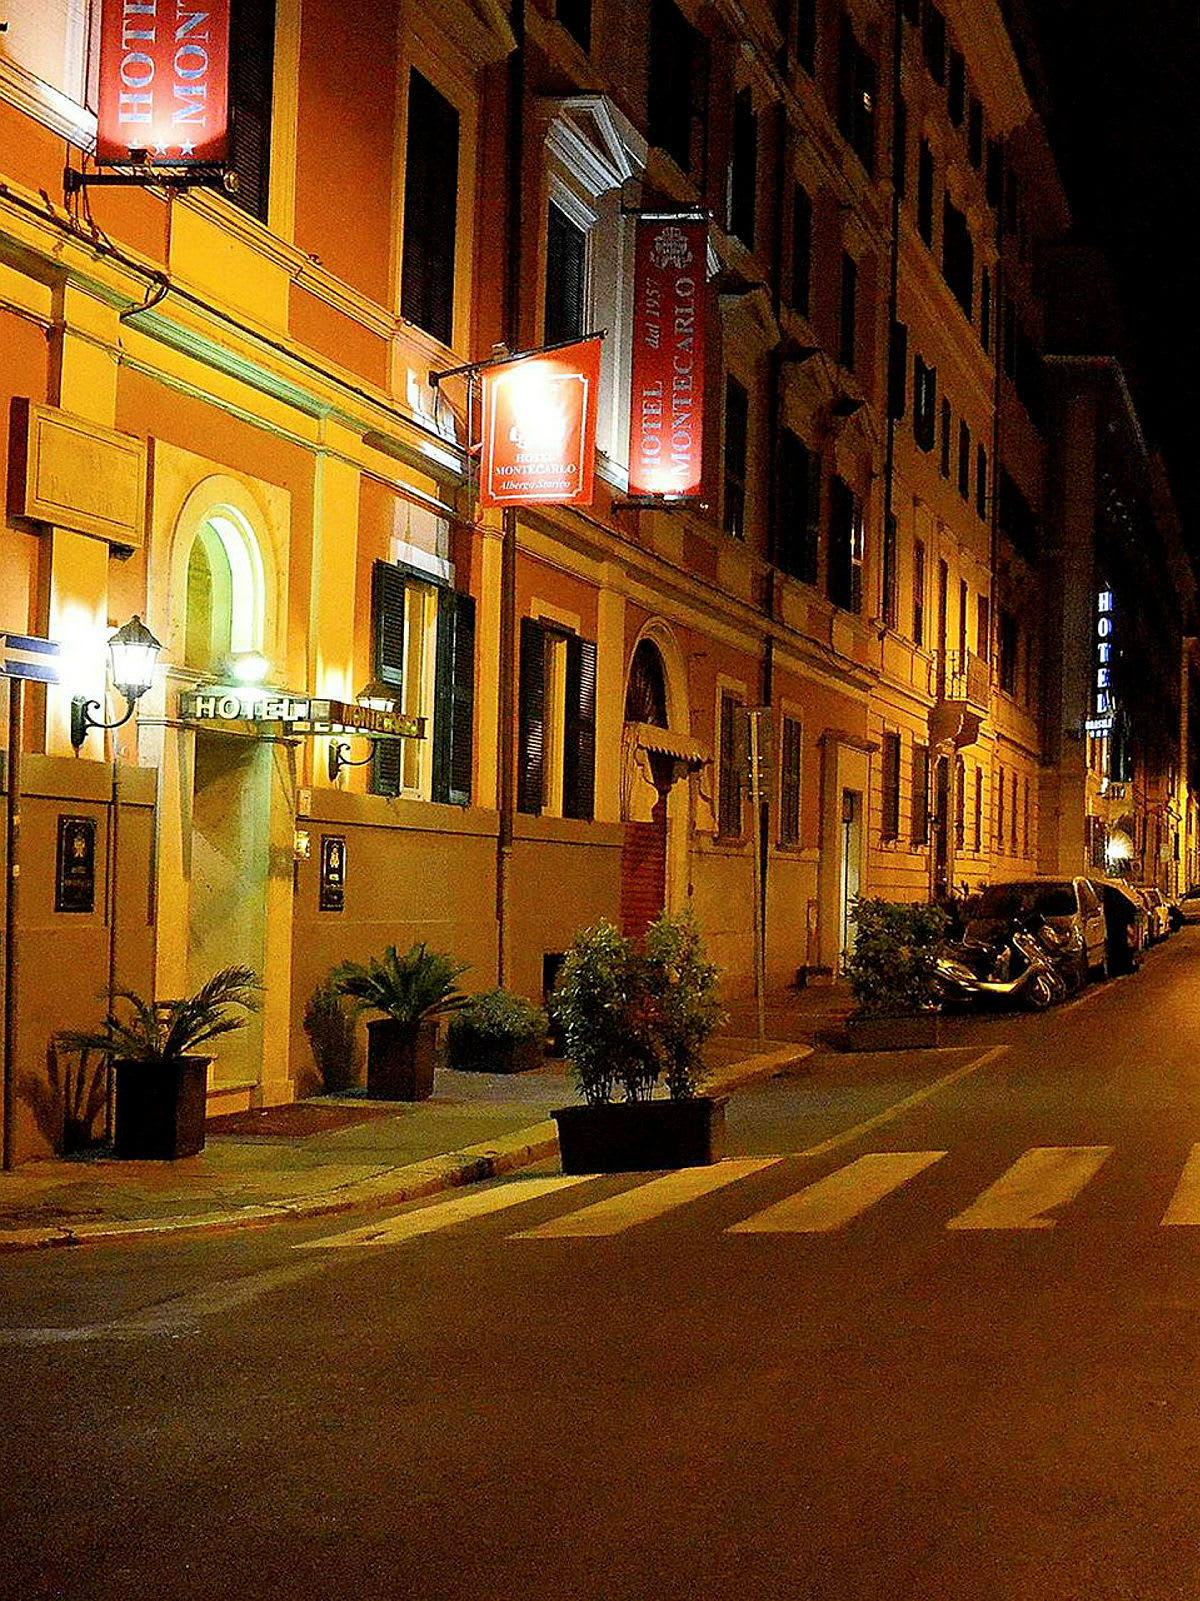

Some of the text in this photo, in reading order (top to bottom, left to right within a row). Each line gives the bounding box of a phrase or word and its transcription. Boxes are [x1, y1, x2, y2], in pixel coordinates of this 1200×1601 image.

[171, 0, 210, 128] MON
[640, 381, 664, 476] HOTEL
[670, 277, 696, 478] MONTECARLO
[495, 464, 577, 477] MONTECARLO
[1097, 591, 1112, 713] HOTEL
[195, 697, 297, 721] HOTEL
